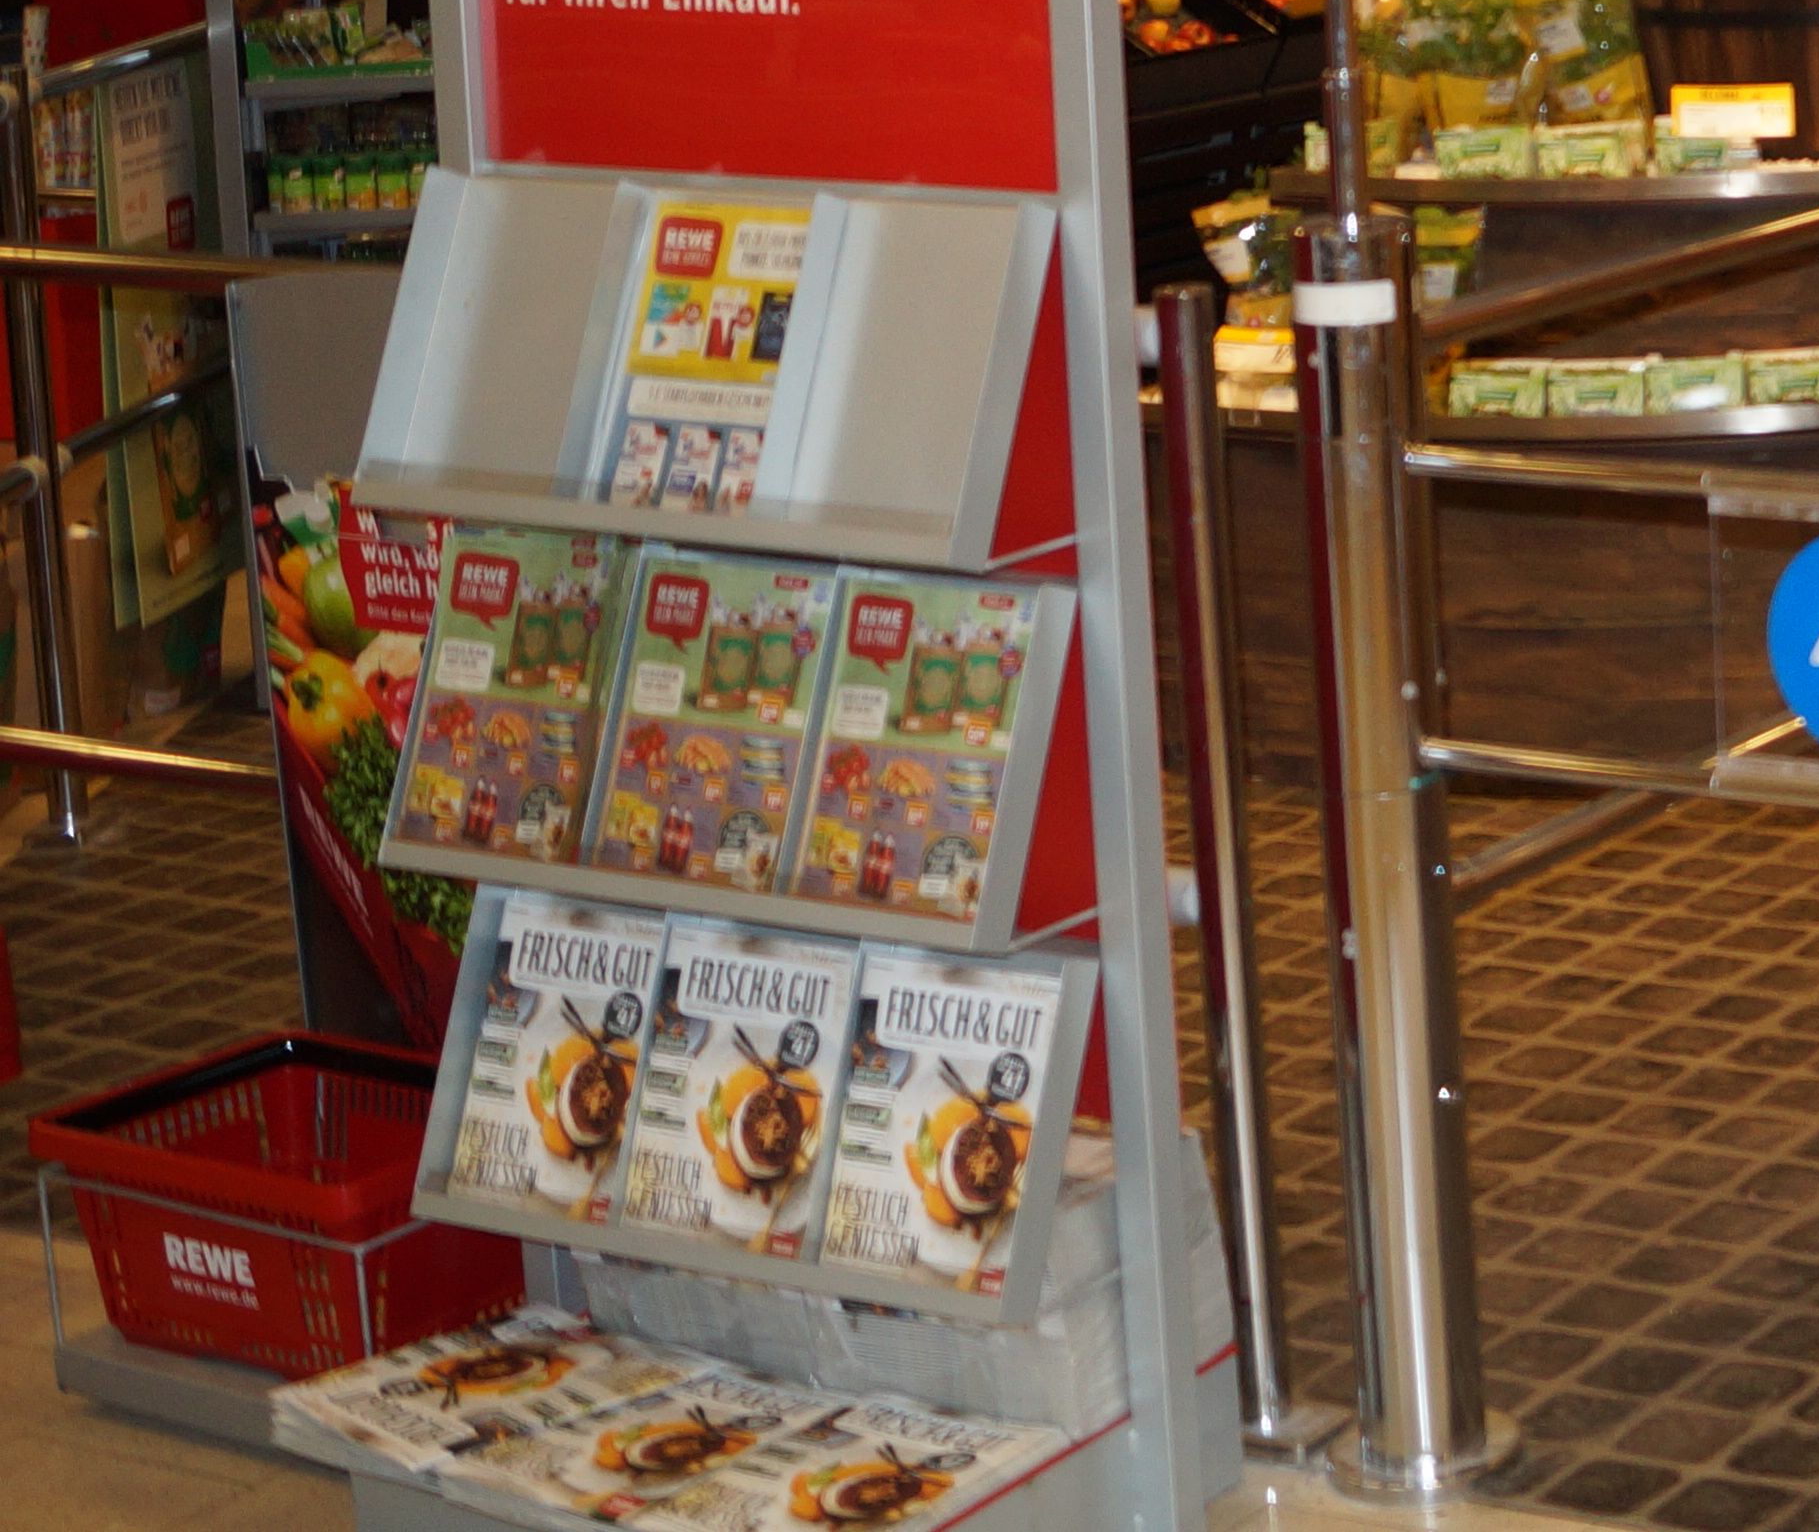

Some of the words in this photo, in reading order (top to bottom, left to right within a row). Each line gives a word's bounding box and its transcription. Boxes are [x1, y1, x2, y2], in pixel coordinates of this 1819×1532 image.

[364, 566, 421, 600] gleich
[517, 928, 590, 982] FRISCH
[611, 943, 655, 990] GUT
[686, 954, 765, 1007] FRISCH
[786, 969, 830, 1018] GUT
[885, 985, 970, 1040] FRISCH
[995, 1000, 1043, 1050] GUT
[163, 1231, 256, 1289] REWE
[170, 1273, 260, 1311] www.rewe.de
